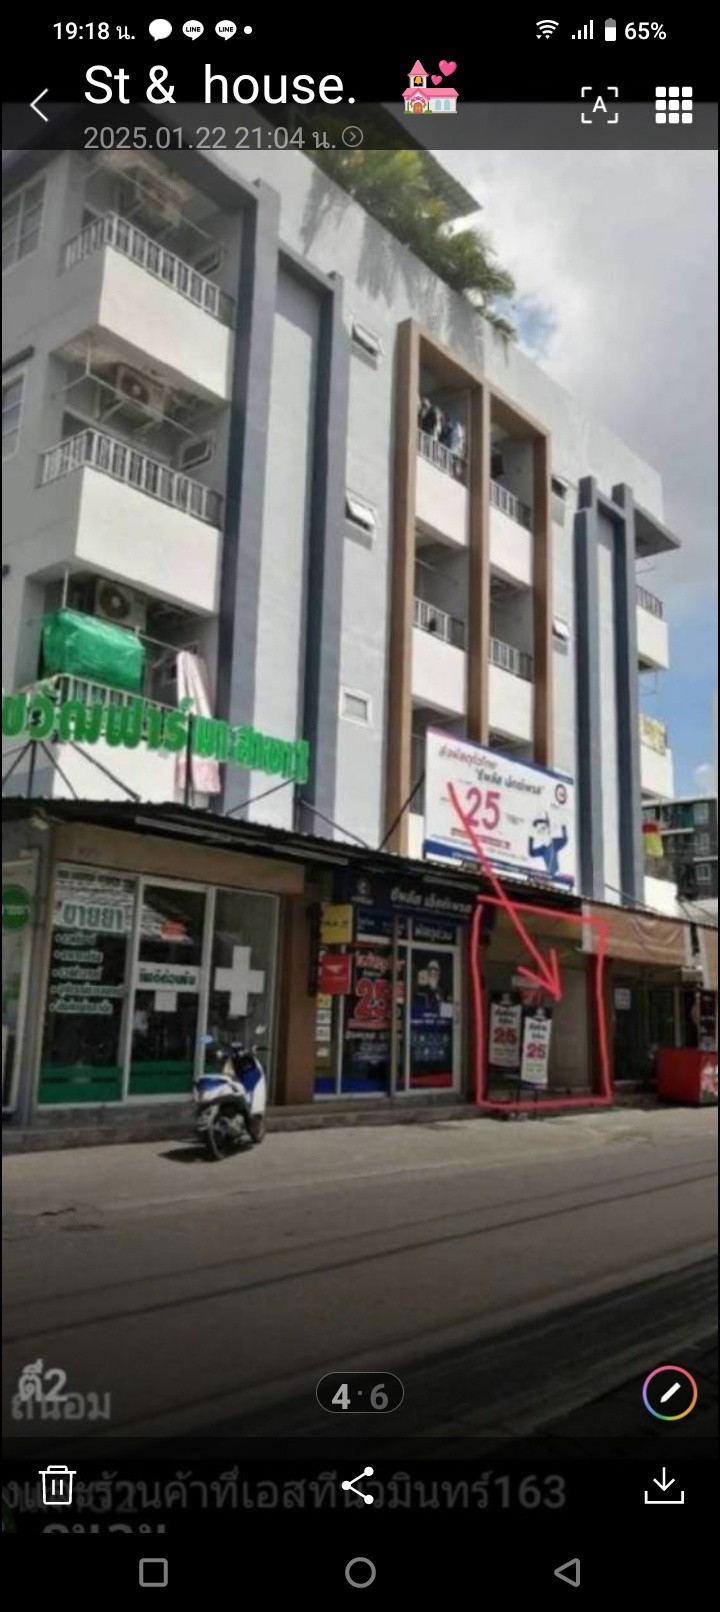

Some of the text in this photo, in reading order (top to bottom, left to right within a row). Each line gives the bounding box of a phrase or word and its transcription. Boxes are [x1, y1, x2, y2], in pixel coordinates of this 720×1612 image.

[466, 787, 501, 830] 25
[63, 903, 123, 931] ขายยา
[493, 1026, 518, 1045] 25
[526, 1043, 547, 1060] 25
